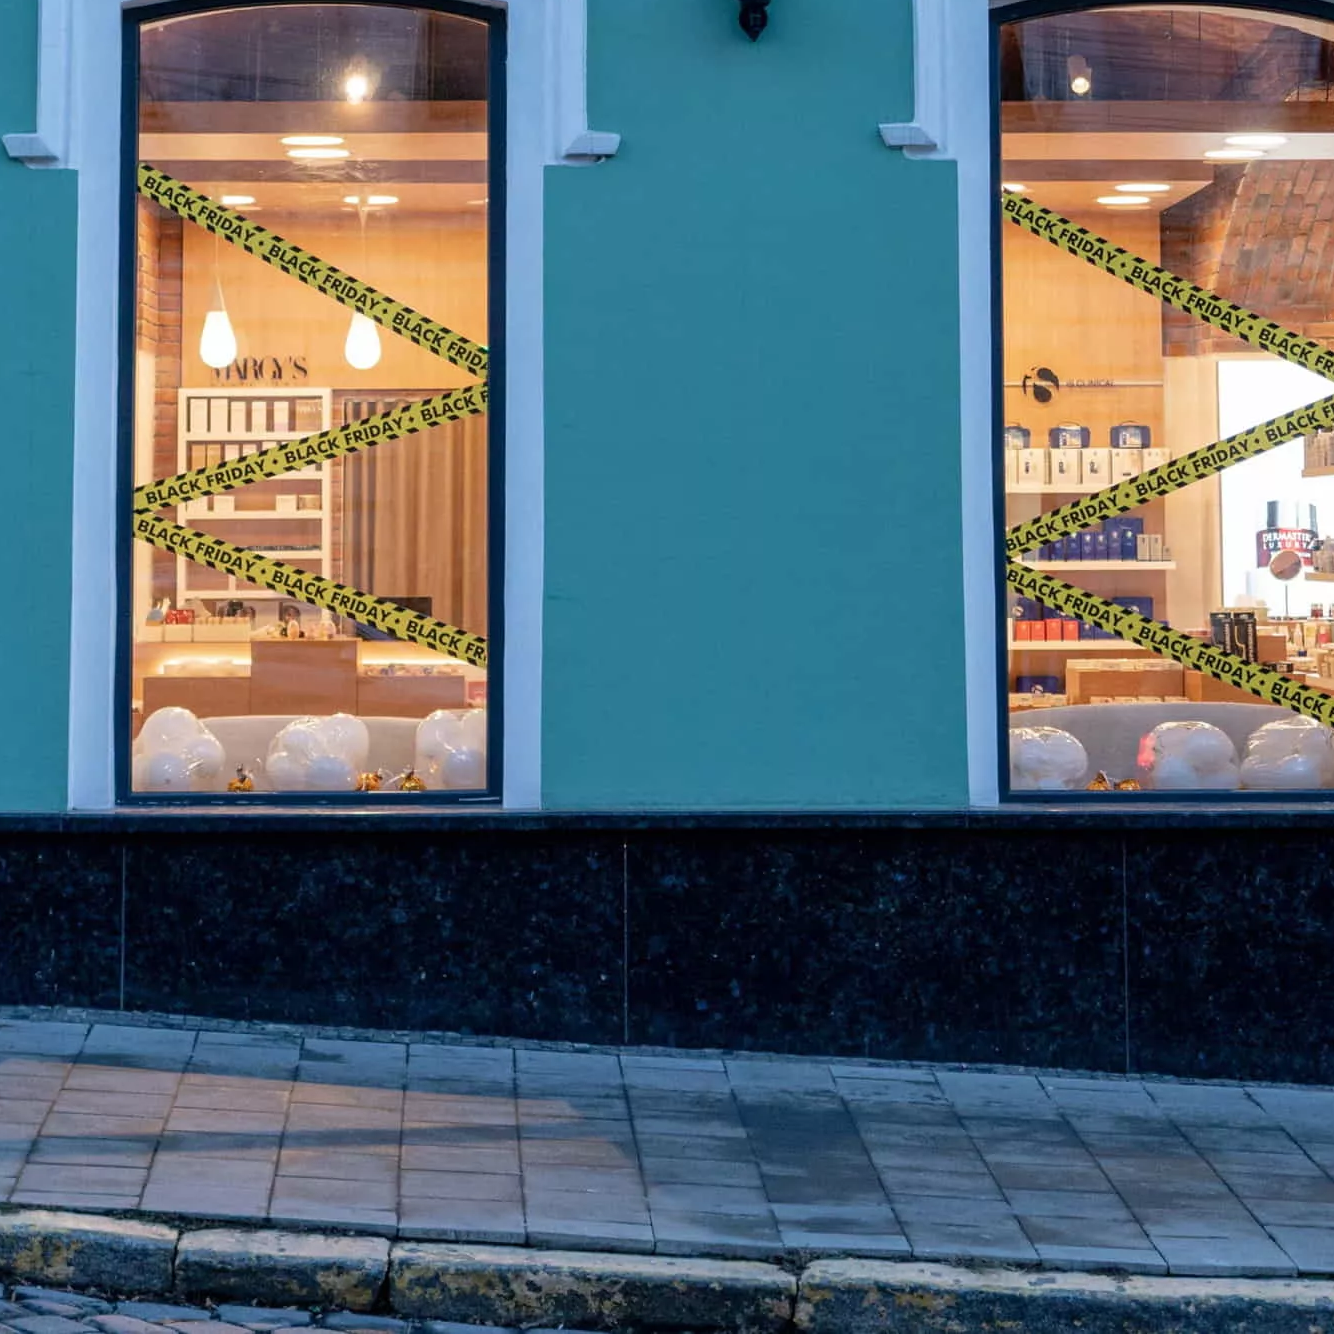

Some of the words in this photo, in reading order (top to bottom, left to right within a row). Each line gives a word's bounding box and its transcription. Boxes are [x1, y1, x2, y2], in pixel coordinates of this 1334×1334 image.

[143, 176, 196, 211] BLACK
[197, 204, 255, 243] FRIDAY
[268, 243, 320, 279] BLACK
[322, 273, 380, 312] FRIDAY
[392, 311, 446, 348] BLACK
[1005, 199, 1057, 234] BLACK
[1059, 228, 1117, 266] FRIDAY
[1130, 265, 1183, 301] BLACK
[1186, 292, 1245, 331] FRIDAY
[1259, 328, 1312, 362] BLACK
[146, 478, 201, 505] BLACK
[205, 459, 265, 488] FRIDAY
[284, 436, 340, 464] BLACK
[344, 416, 404, 446] FRIDAY
[421, 394, 476, 422] BLACK
[1007, 520, 1059, 552] BLACK
[1061, 494, 1118, 528] FRIDAY
[1135, 464, 1189, 497] BLACK
[1194, 438, 1251, 474] FRIDAY
[1267, 410, 1319, 442] BLACK
[137, 519, 191, 550] BLACK
[195, 541, 257, 574] FRIDAY
[271, 570, 326, 600] BLACK
[330, 592, 392, 625] FRIDAY
[405, 620, 462, 651] BLACK
[1007, 569, 1059, 600] BLACK
[1064, 593, 1122, 628] FRIDAY
[1139, 627, 1192, 659] BLACK
[1196, 651, 1256, 685] FRIDAY
[1270, 682, 1325, 715] BLACK
